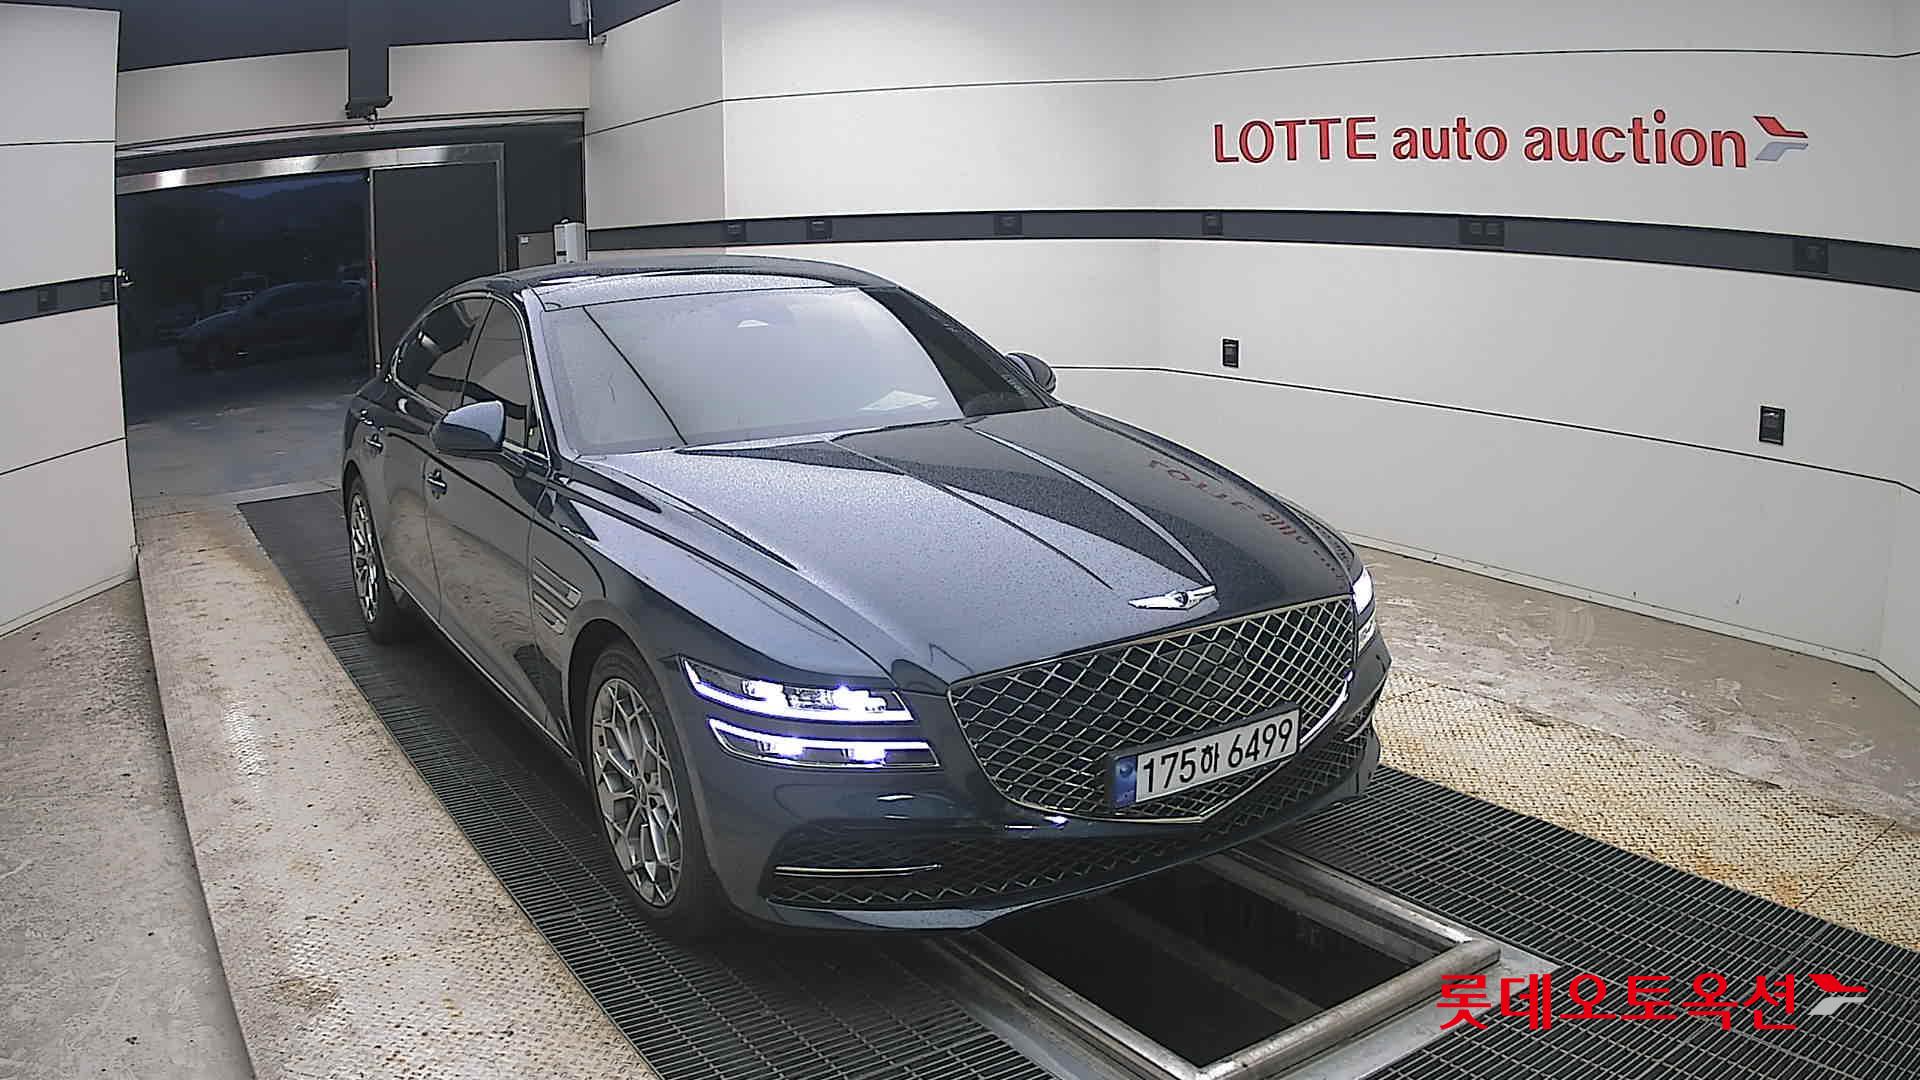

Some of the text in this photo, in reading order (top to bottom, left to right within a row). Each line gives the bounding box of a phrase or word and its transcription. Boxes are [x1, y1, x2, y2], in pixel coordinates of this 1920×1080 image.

[1213, 108, 1748, 169] LOTTE auto auction
[1142, 717, 1294, 793] 175하 6499
